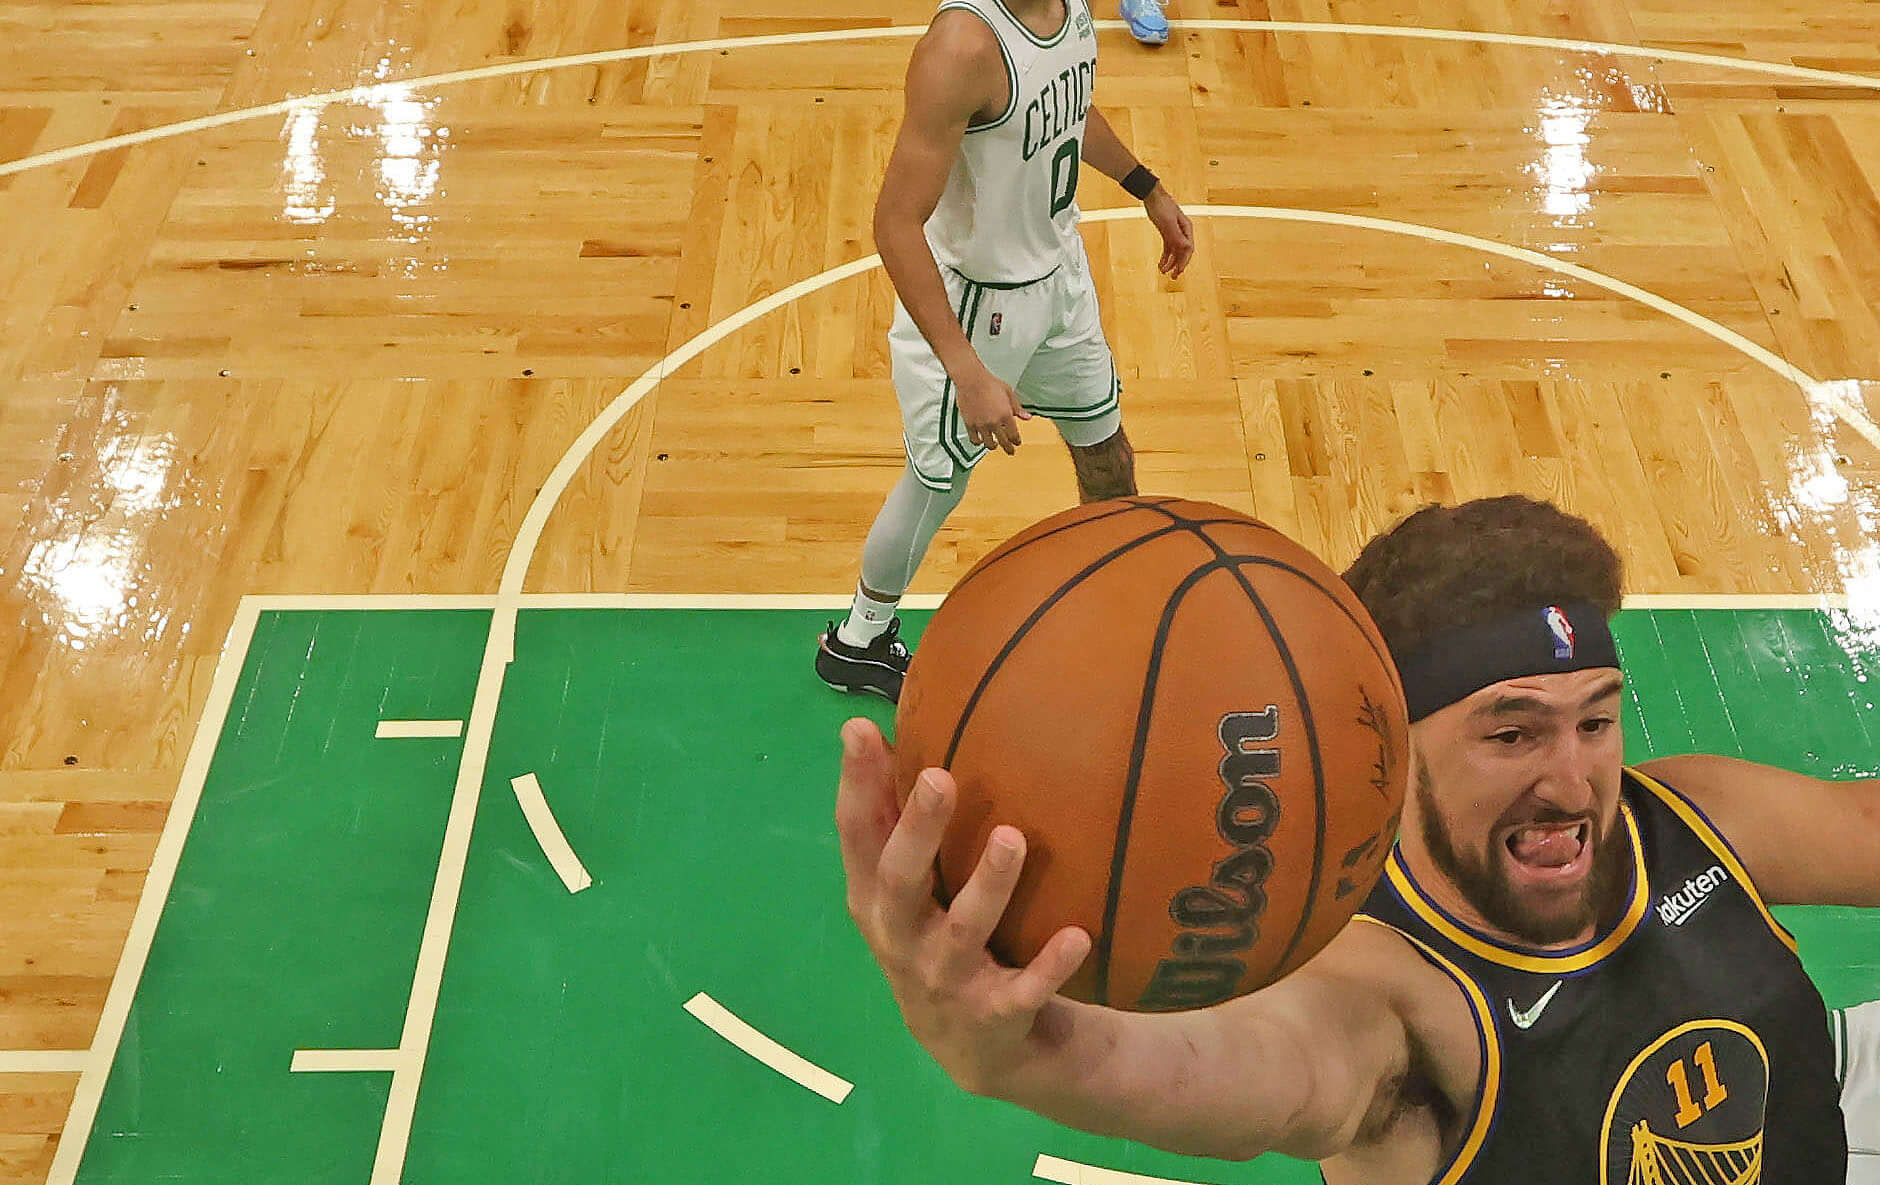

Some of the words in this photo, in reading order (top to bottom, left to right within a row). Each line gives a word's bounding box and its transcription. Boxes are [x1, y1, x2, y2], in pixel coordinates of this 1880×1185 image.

[1050, 137, 1079, 219] 0
[1655, 865, 1728, 926] akuten
[1666, 1041, 1728, 1129] 11
